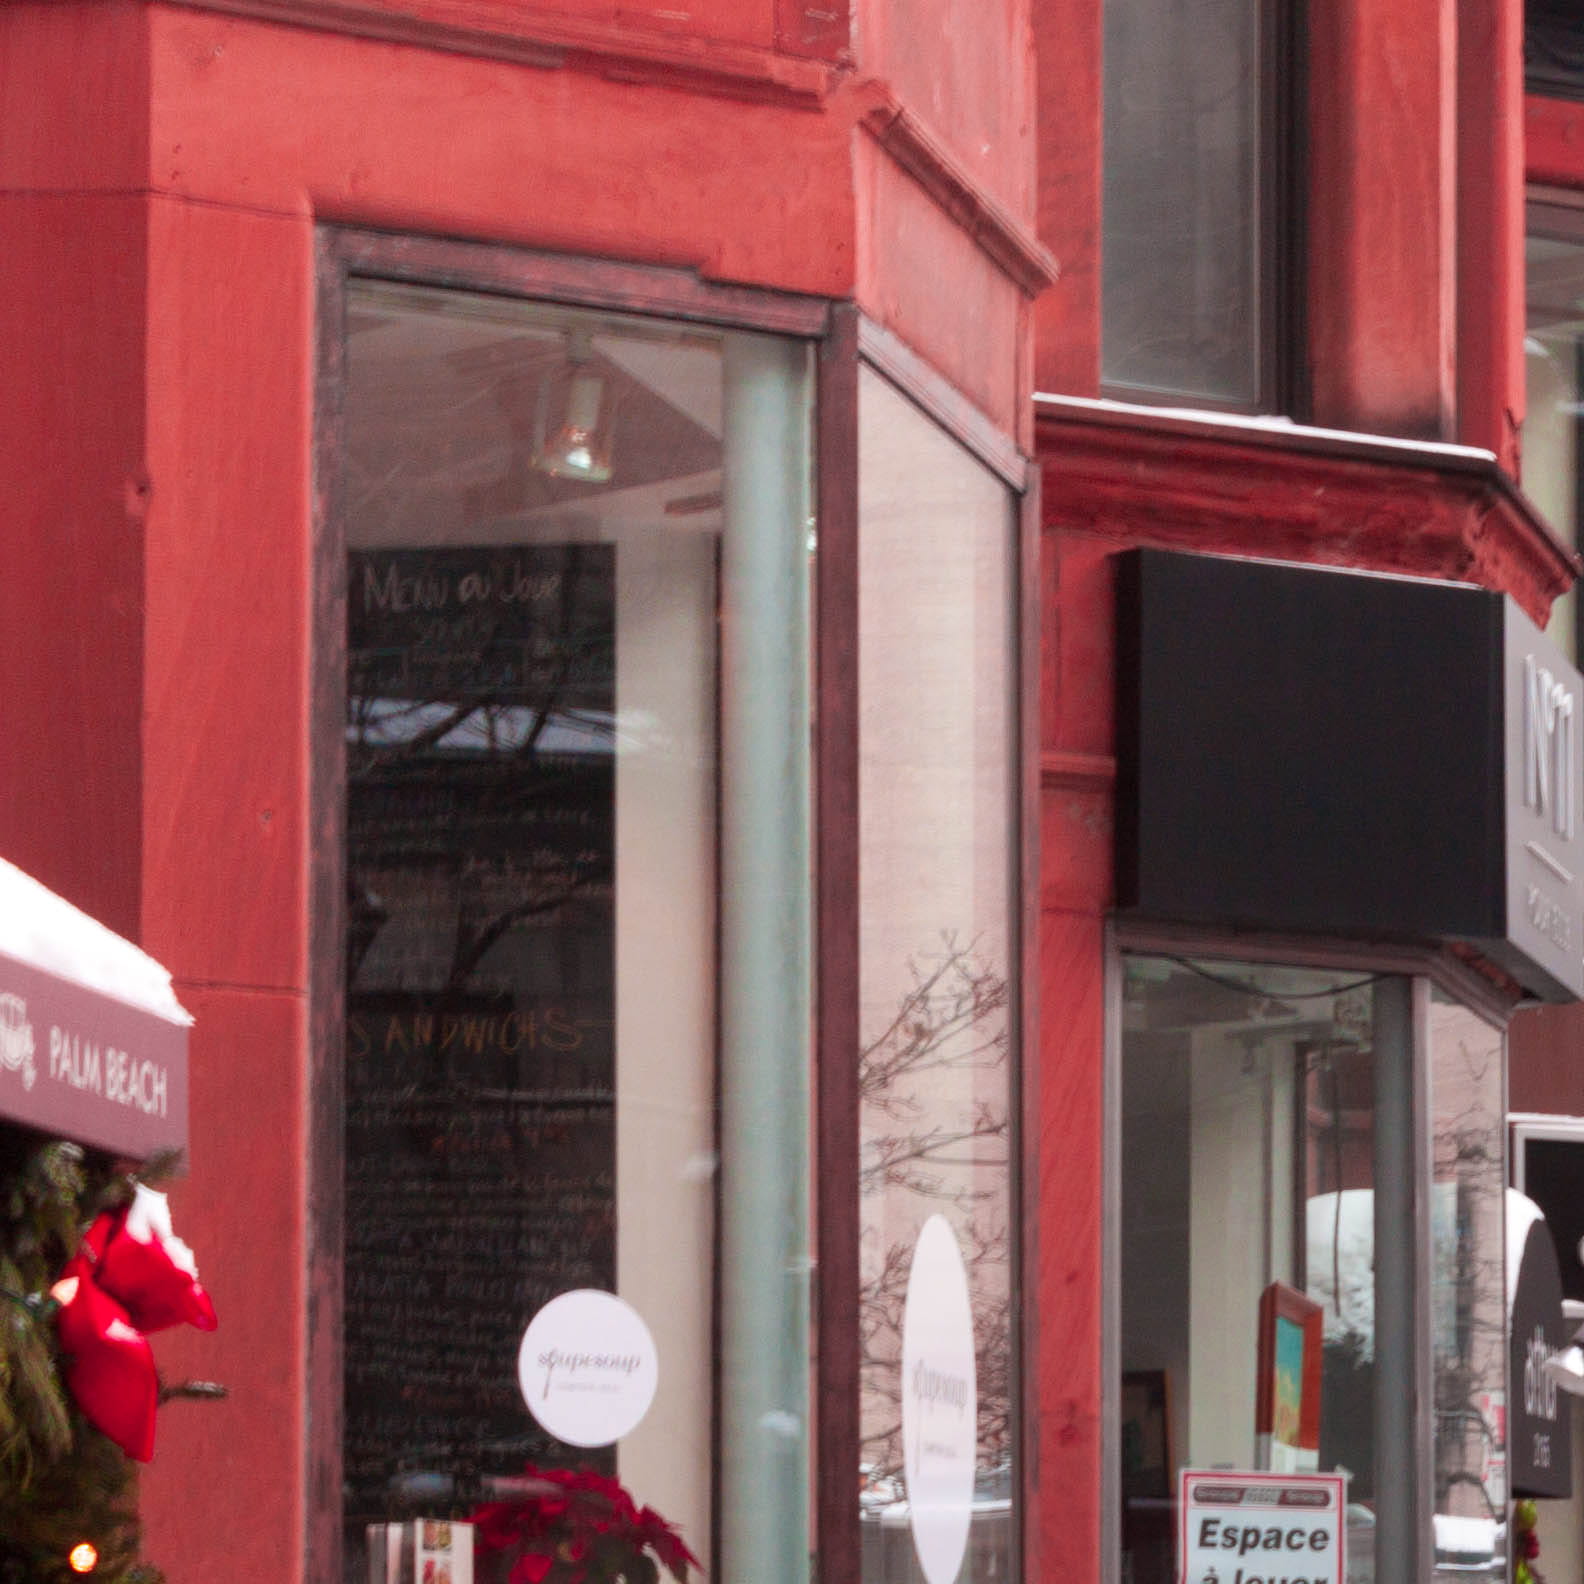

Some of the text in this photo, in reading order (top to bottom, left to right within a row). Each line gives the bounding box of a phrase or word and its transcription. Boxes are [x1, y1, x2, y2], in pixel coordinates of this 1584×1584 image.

[50, 1025, 168, 1119] PALM BEACH
[1198, 1518, 1330, 1556] Espace
